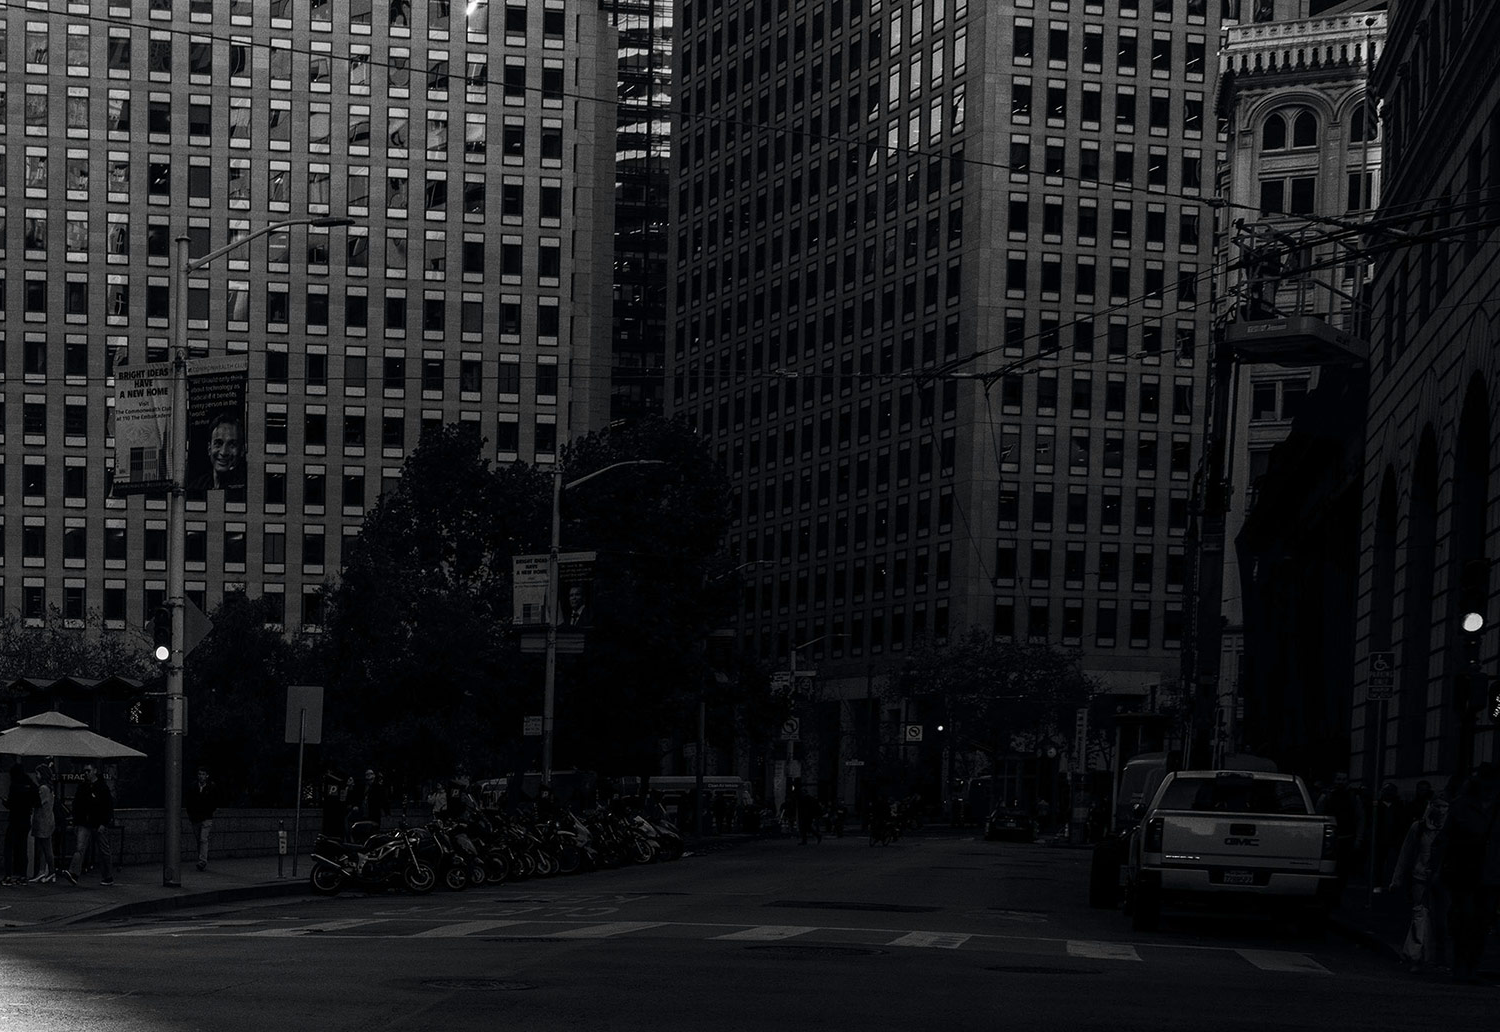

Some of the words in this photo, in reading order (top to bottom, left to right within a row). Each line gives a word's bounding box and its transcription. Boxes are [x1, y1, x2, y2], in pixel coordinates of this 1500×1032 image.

[119, 370, 145, 380] BRIGHT
[147, 368, 169, 377] IDEAS
[134, 379, 153, 388] HAVE
[120, 391, 125, 399] A
[127, 389, 144, 398] NEW
[146, 387, 168, 396] HOME
[1224, 837, 1260, 847] GMC
